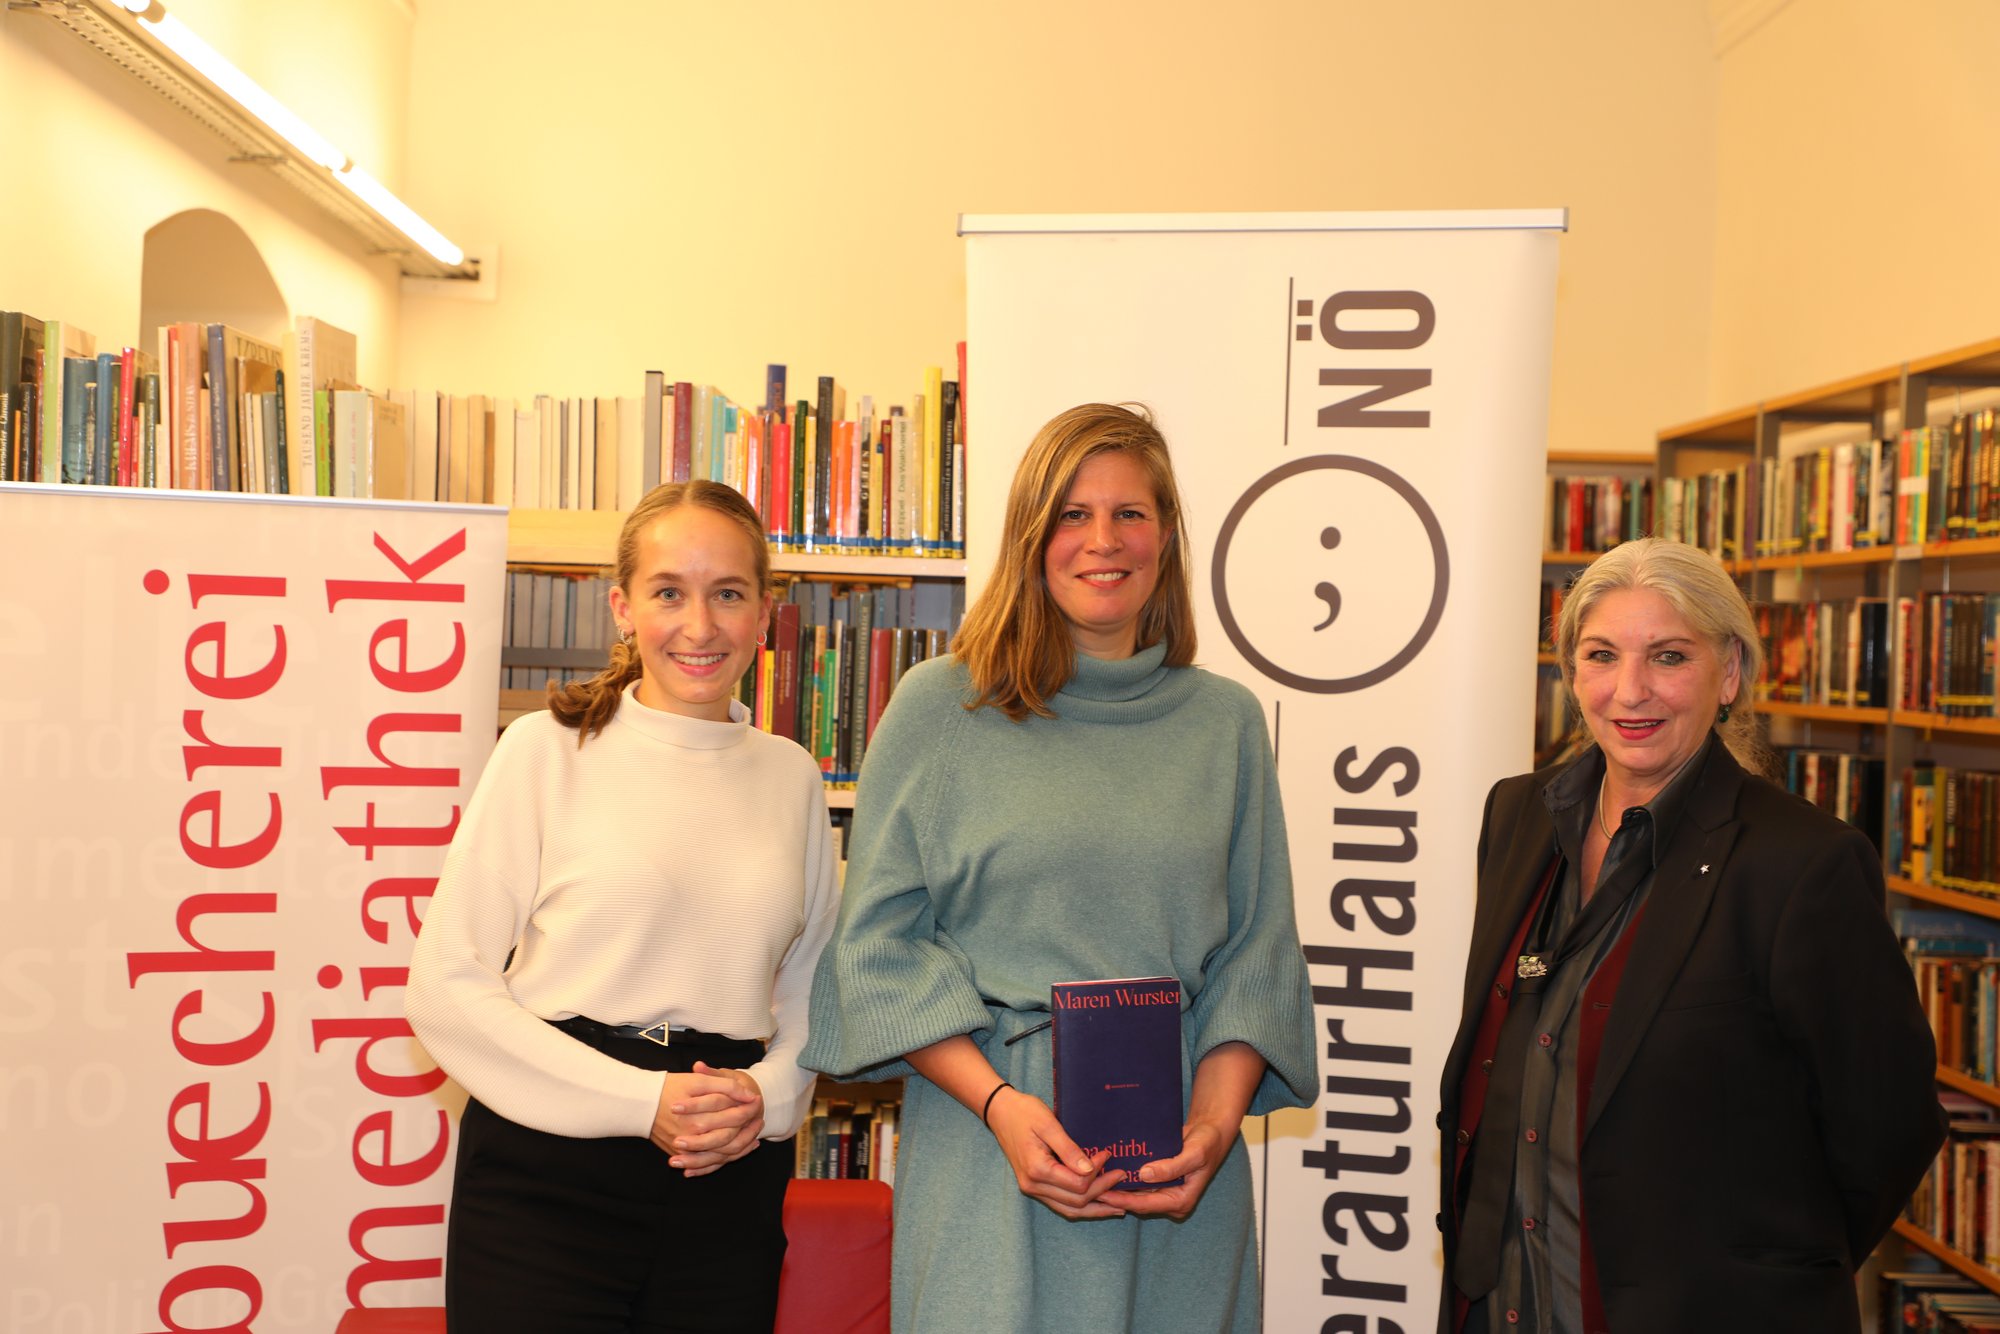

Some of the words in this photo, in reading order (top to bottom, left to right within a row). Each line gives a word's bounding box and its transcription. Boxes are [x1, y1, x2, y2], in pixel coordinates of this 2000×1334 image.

[300, 329, 311, 368] KREMS
[1295, 290, 1436, 428] NÖ
[301, 374, 312, 411] JAHRE
[302, 415, 313, 468] TAUSEND
[312, 527, 467, 1310] mediathek
[1054, 990, 1111, 1010] Maren
